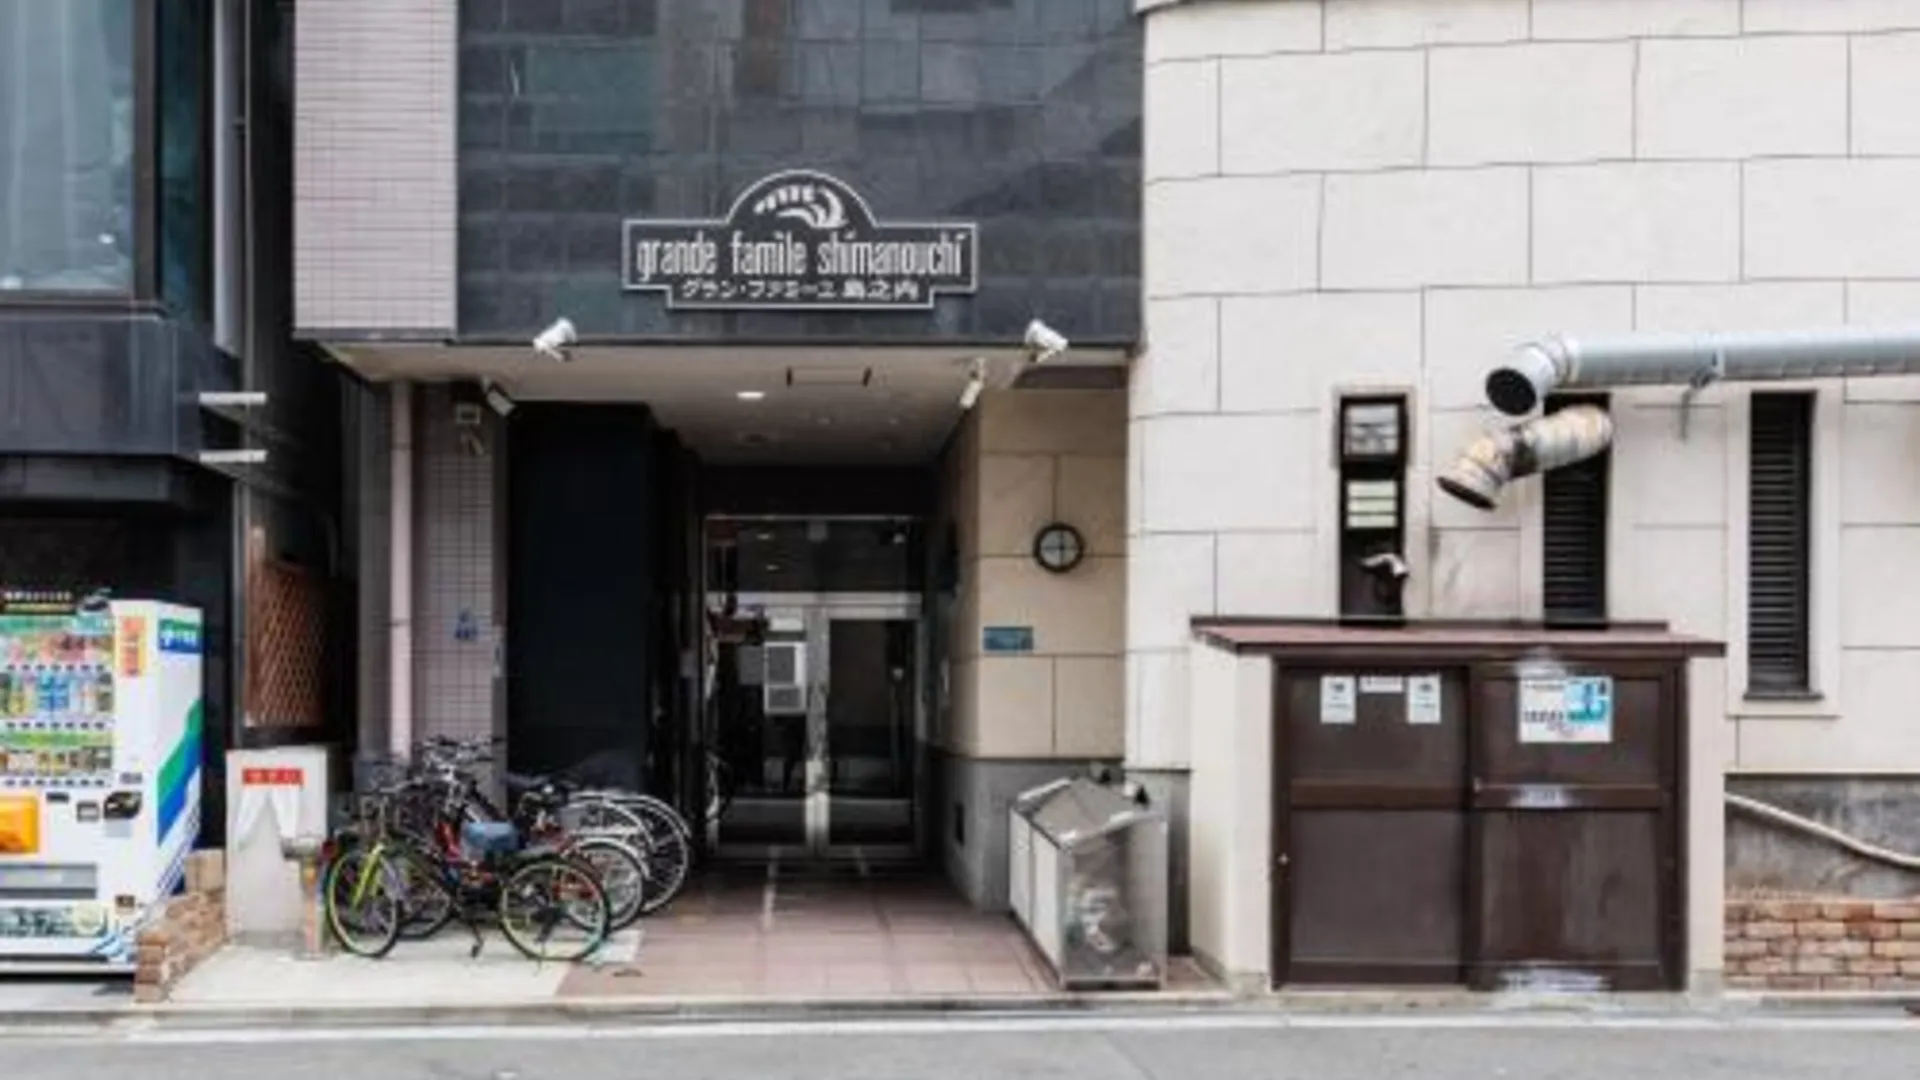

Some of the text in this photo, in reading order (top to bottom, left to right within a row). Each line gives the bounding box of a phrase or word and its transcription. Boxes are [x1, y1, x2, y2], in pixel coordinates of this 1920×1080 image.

[636, 231, 966, 281] grande famile shimanouchi
